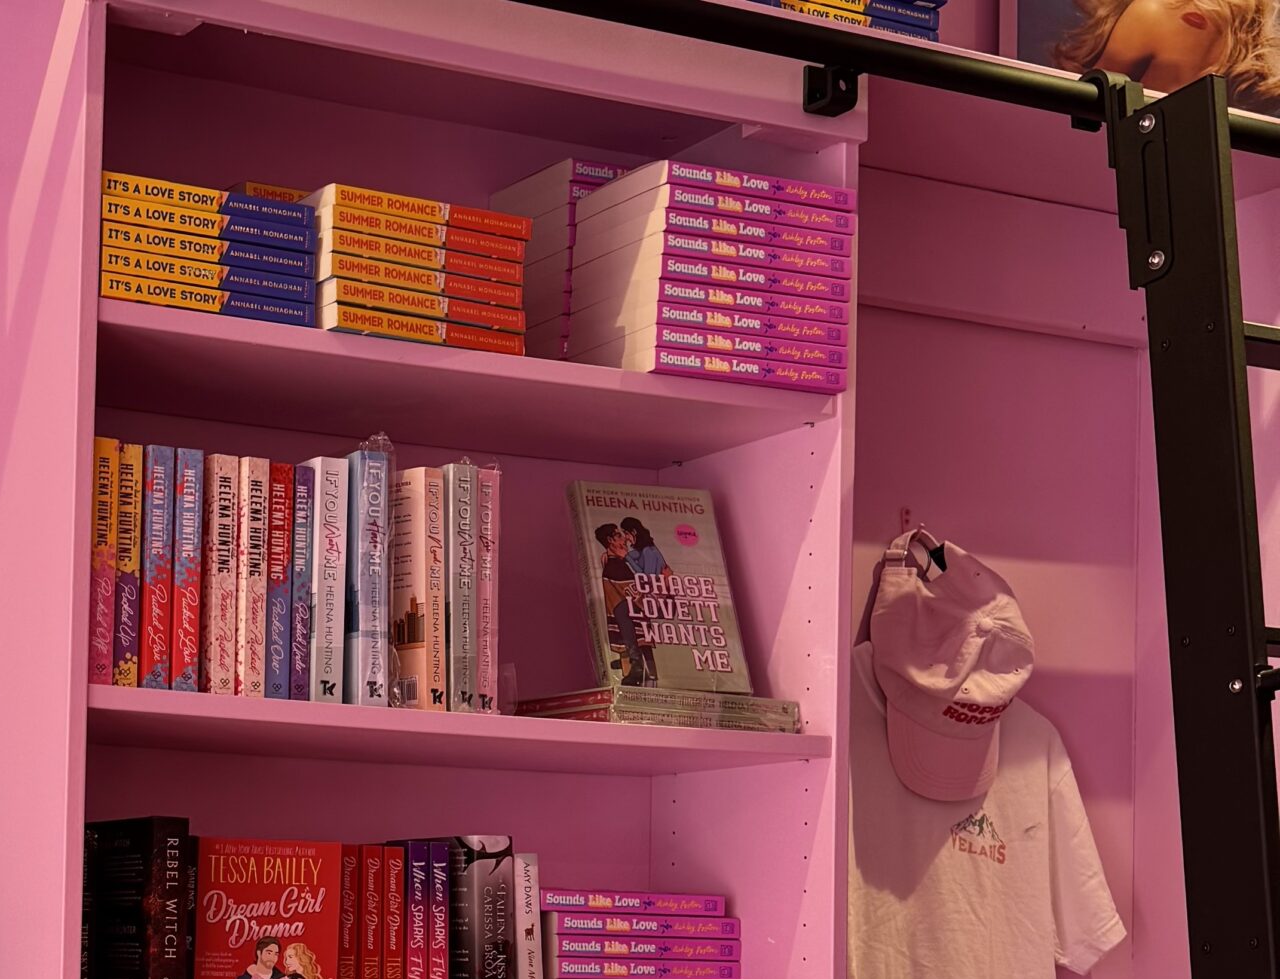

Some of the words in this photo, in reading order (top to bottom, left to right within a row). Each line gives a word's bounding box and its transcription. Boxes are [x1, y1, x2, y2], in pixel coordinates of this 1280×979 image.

[672, 163, 712, 182] Sounds
[715, 170, 740, 188] Like
[742, 176, 769, 191] Love
[106, 178, 129, 194] IT'S
[133, 185, 142, 196] A
[145, 186, 174, 200] LOVE
[178, 190, 216, 207] STORY
[340, 188, 382, 208] SUMMER
[387, 197, 438, 218] ROMANCE
[229, 200, 260, 213] ANNABEL
[262, 206, 303, 219] MONAGHAN
[218, 476, 232, 520] HELENA
[585, 495, 638, 510] HELENA
[642, 499, 705, 515] HUNTING
[217, 524, 231, 574] HUNTING
[634, 572, 716, 598] CHASE
[325, 585, 334, 627] HELENA
[626, 596, 720, 622] LOVETT
[642, 621, 726, 648] WANTS
[323, 630, 334, 674] HUNTING
[692, 648, 732, 672] ME
[166, 838, 180, 890] REBEL
[208, 855, 258, 884] TESSA
[263, 857, 323, 886] BAILEY
[524, 862, 532, 883] AMY
[433, 862, 447, 901] When
[203, 890, 276, 923] Dream
[280, 886, 326, 918] Girl
[524, 886, 534, 915] DAWS
[546, 893, 585, 905] Sounds
[588, 894, 612, 908] Like
[614, 895, 640, 906] Love
[164, 898, 178, 959] WITCH
[226, 916, 305, 948] Drama
[432, 904, 445, 949] SPARKS
